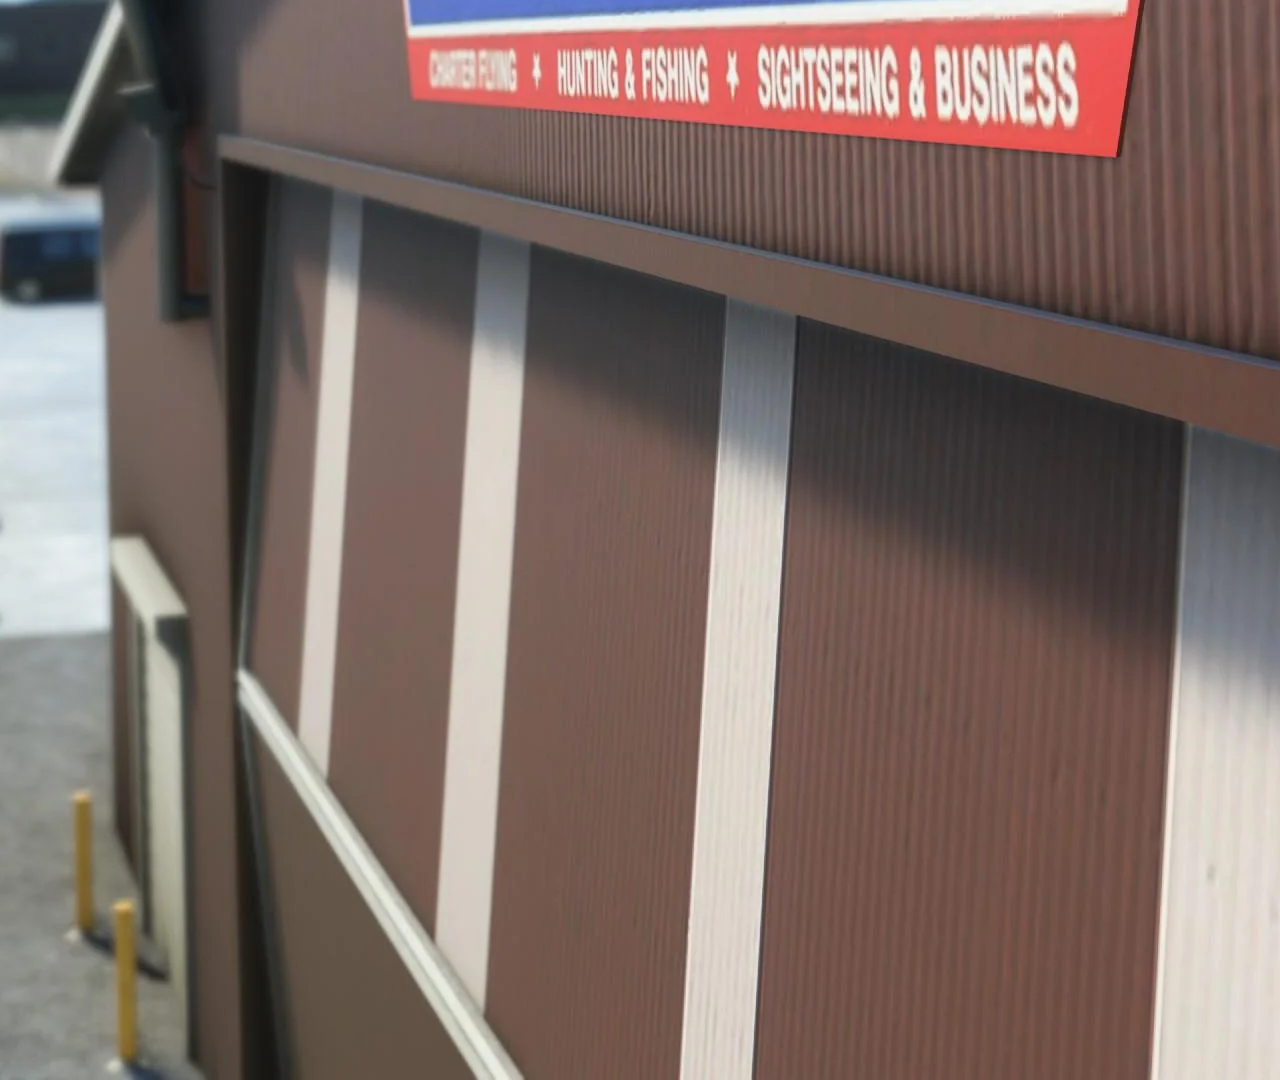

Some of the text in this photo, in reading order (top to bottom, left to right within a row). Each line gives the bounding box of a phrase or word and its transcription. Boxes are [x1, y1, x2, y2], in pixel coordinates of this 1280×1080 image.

[429, 41, 1080, 130] CHARTER FLYING HUNTING & FISHING SIGHTSEEING & BUSINESS
